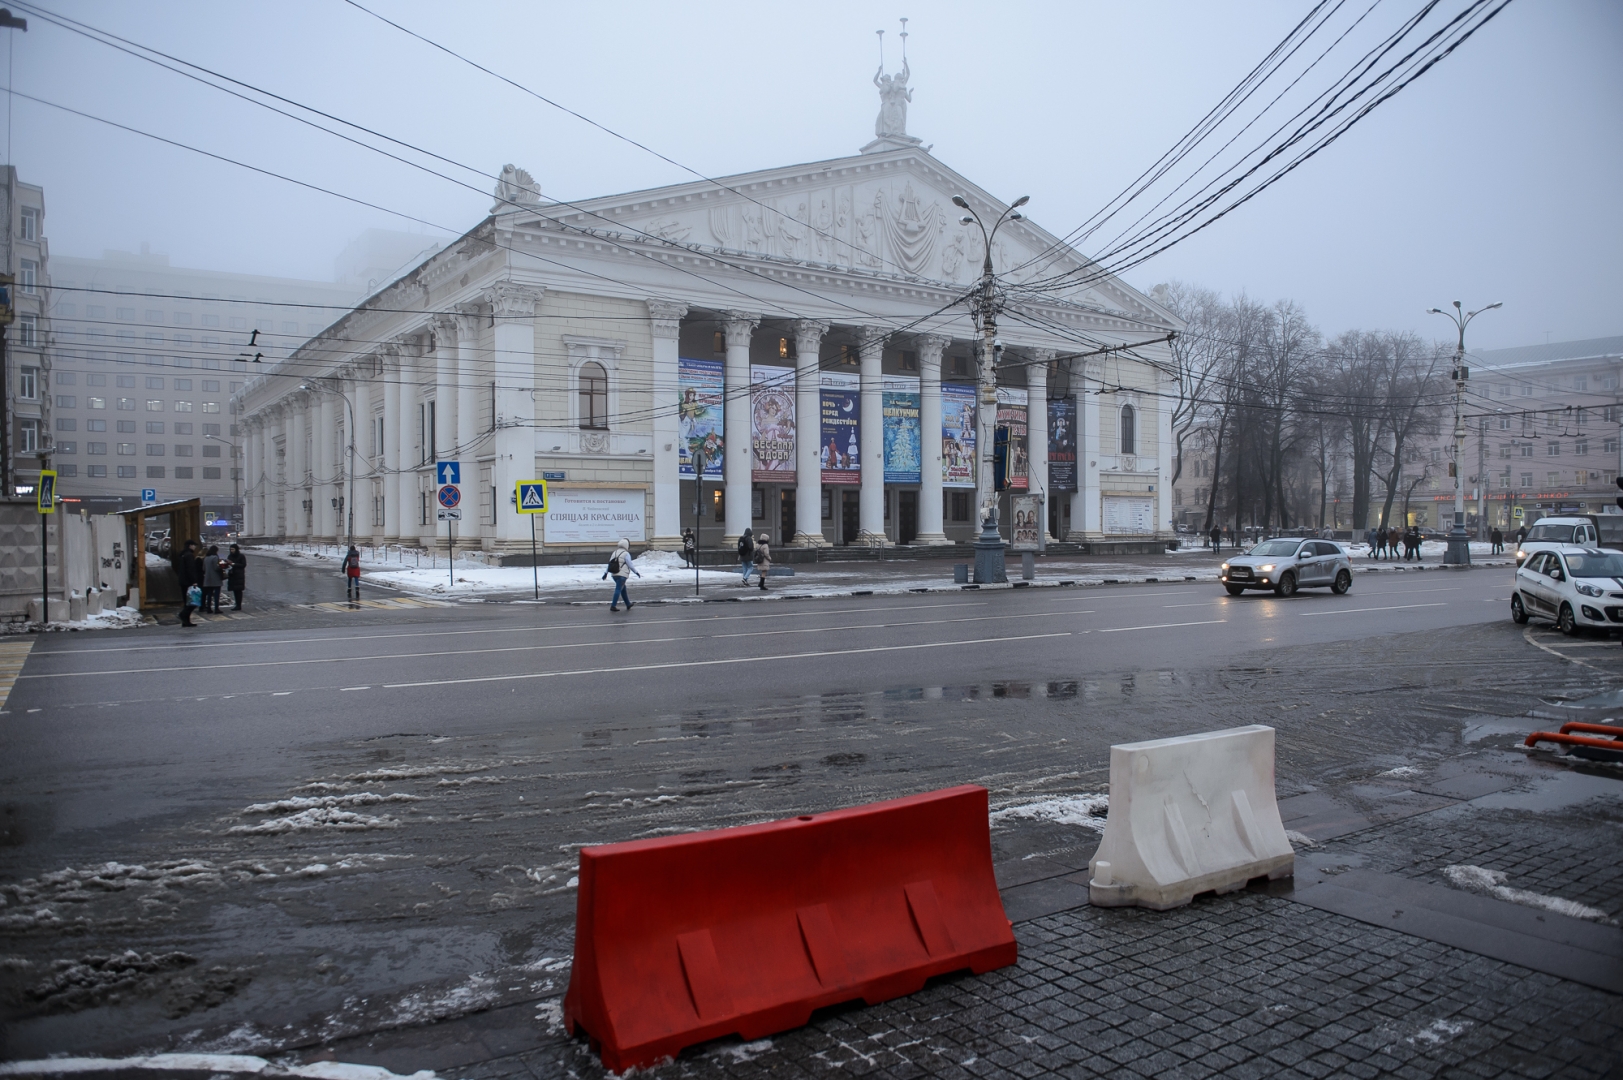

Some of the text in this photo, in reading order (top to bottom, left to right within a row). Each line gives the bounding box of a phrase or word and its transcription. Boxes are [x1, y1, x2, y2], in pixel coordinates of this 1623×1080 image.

[884, 408, 918, 418] ЩЕЛКУНЧИК
[759, 450, 789, 461] ВДОВА
[550, 513, 640, 523] СПЯЩАЯ КРАСАВИЦА
